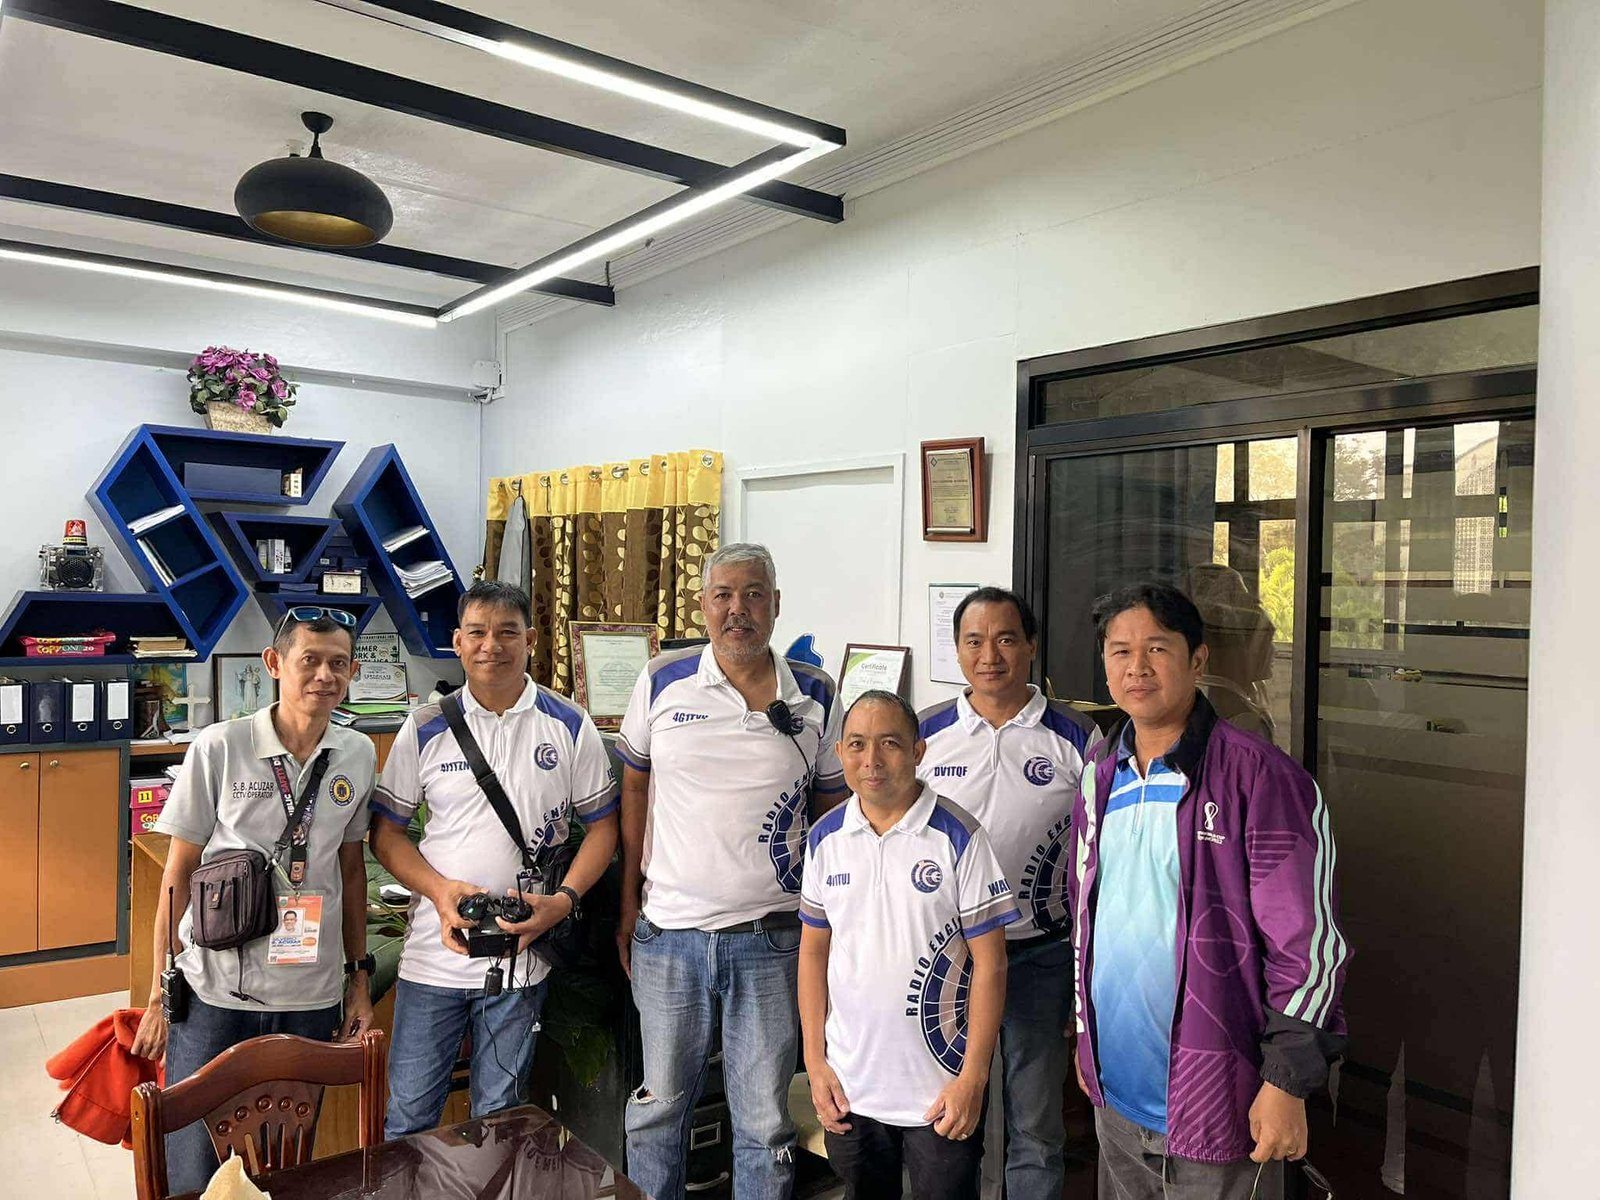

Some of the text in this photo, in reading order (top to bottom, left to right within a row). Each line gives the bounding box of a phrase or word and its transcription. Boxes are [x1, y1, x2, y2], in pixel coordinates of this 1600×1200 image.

[934, 766, 968, 777] DV1TQF
[248, 781, 275, 791] ACUZAR
[140, 792, 150, 801] 11
[232, 791, 273, 799] CCTV OPERATOR
[758, 791, 790, 843] RADIO
[1018, 844, 1046, 900] RADIO
[905, 956, 931, 1017] RADIO
